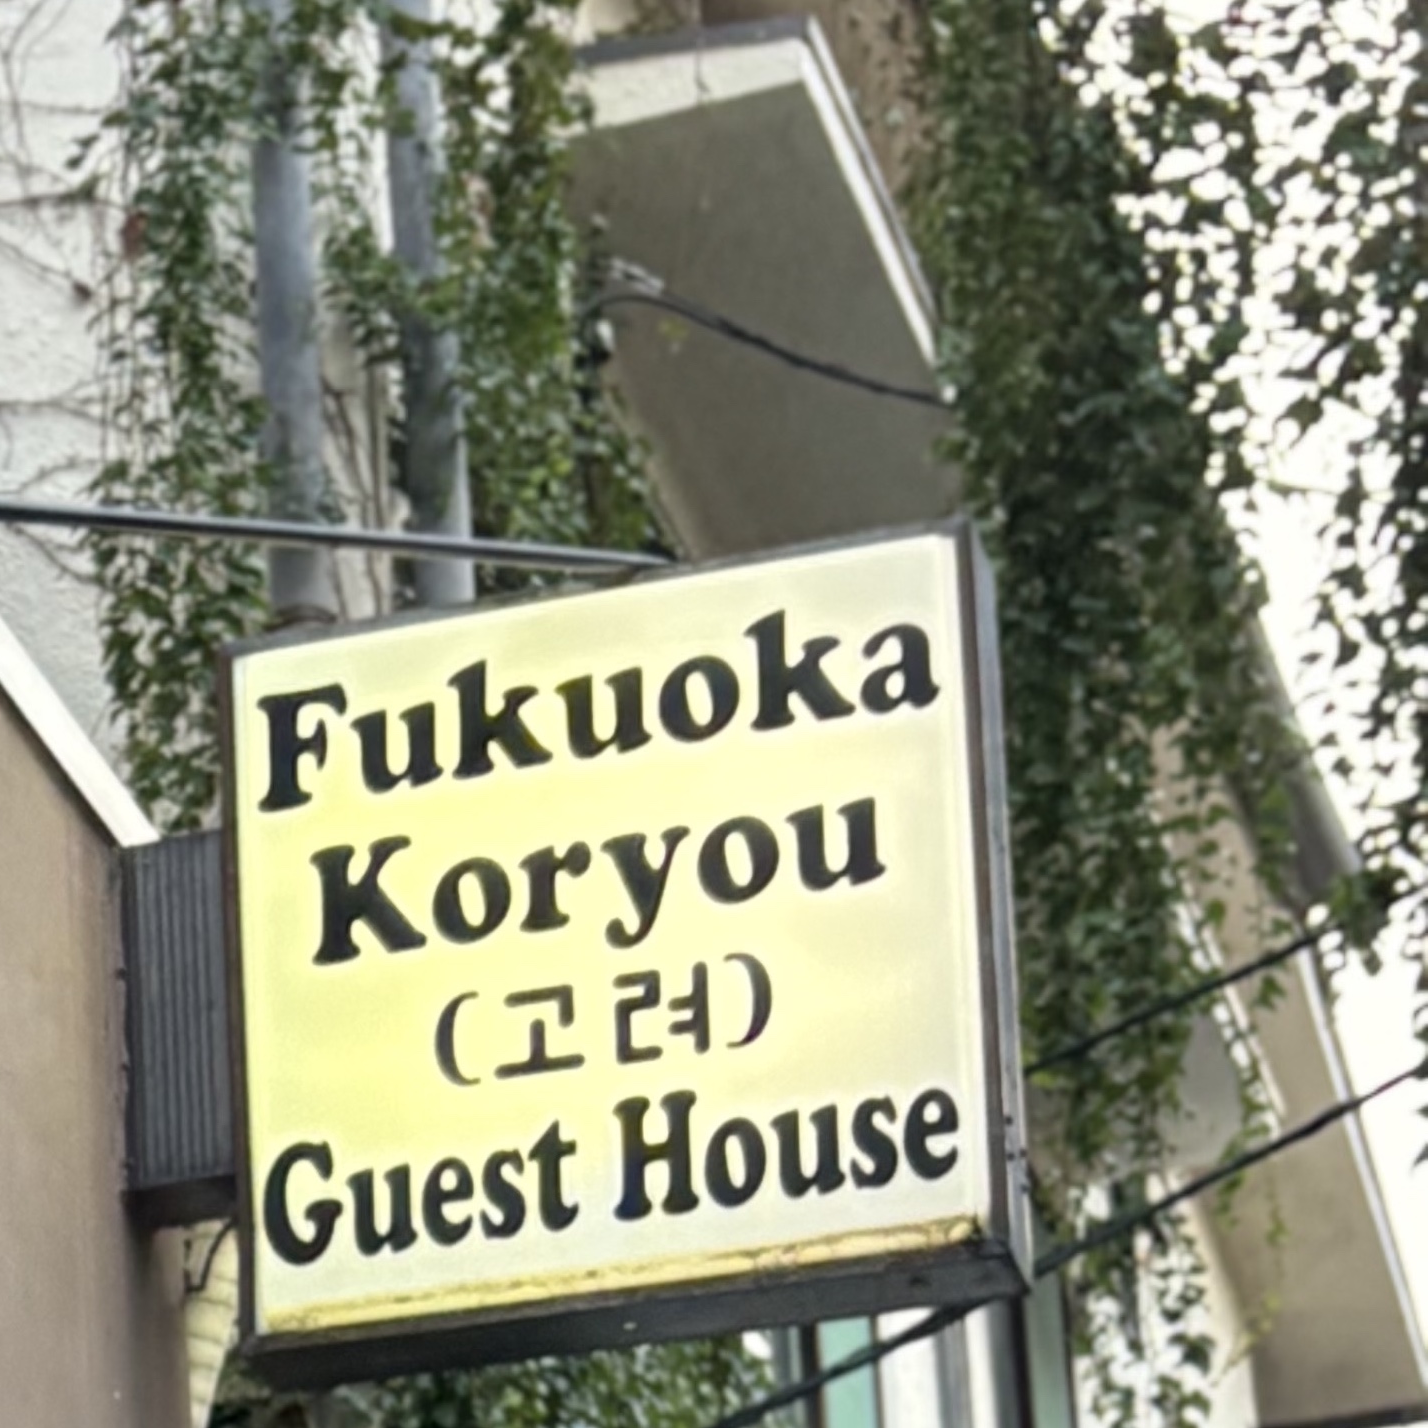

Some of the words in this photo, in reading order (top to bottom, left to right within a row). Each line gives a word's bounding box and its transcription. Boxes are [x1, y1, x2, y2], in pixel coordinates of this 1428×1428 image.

[256, 608, 941, 813] Fukuoka
[309, 795, 887, 966] Koryou
[262, 1120, 580, 1266] Guest
[612, 1087, 960, 1222] House
